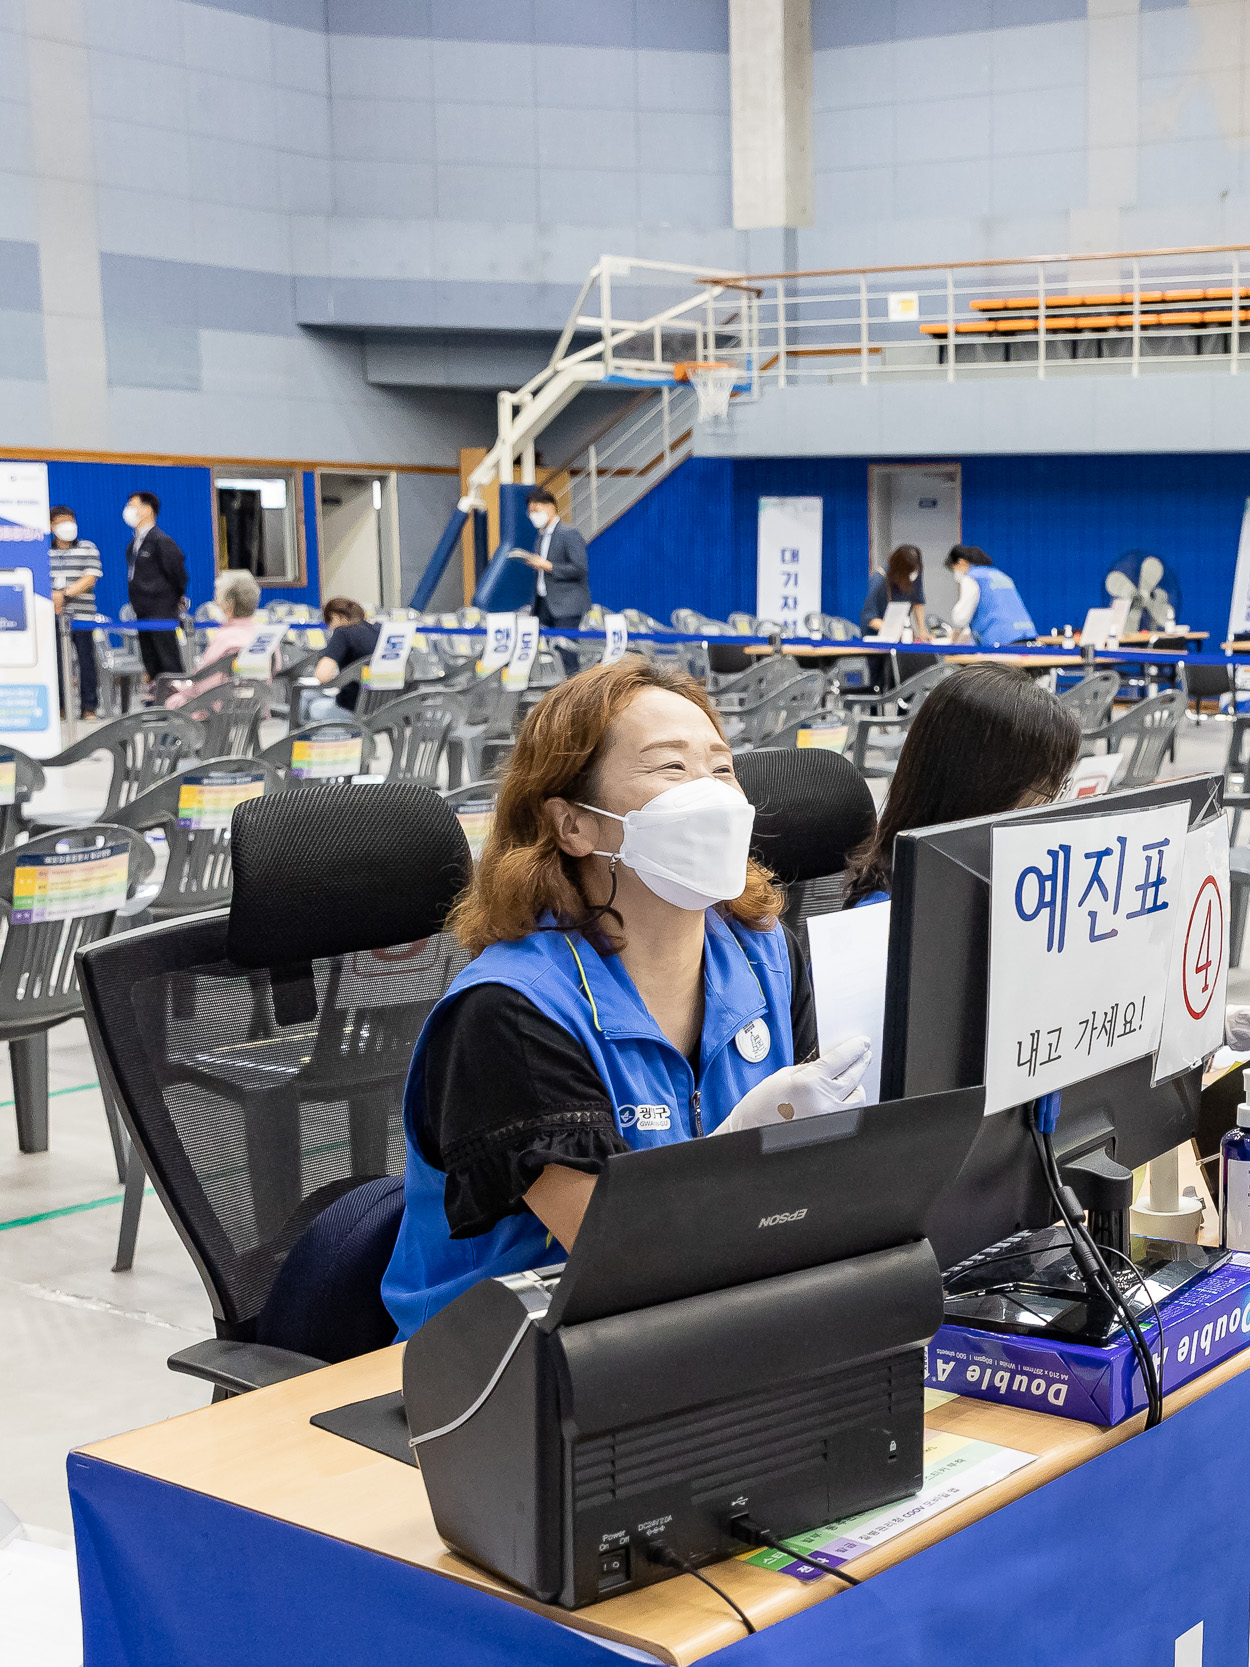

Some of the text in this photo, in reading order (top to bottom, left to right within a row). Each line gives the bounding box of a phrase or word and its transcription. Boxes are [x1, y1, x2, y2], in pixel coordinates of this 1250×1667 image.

[1015, 836, 1171, 953] 예진표
[1016, 995, 1146, 1077] 내고 가세요!
[758, 1208, 808, 1230] EPSON
[966, 1363, 1069, 1407] Double
[602, 1530, 626, 1542] Power
[763, 1547, 799, 1566] 스티
